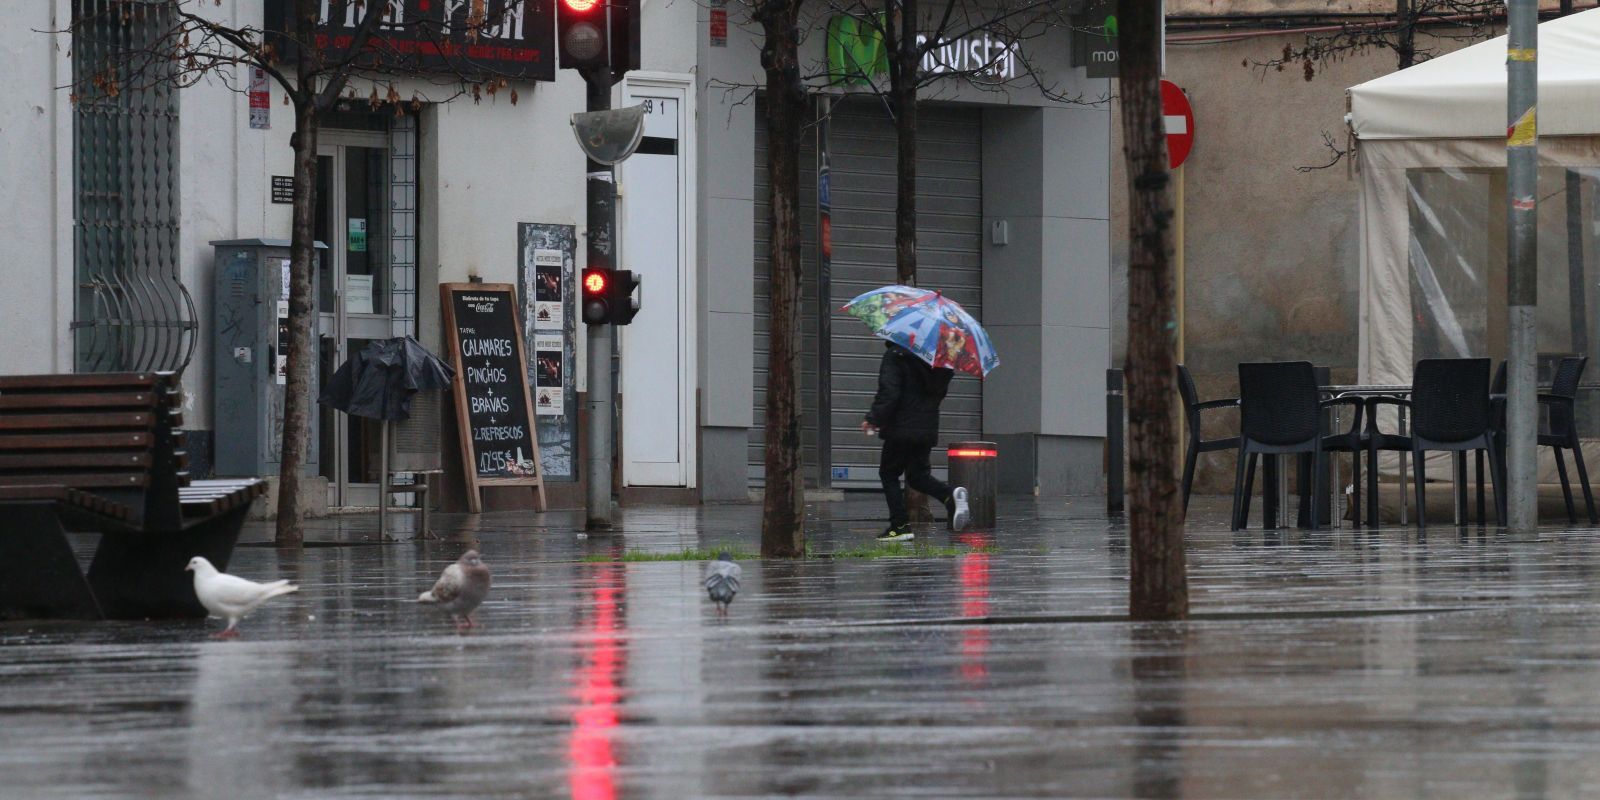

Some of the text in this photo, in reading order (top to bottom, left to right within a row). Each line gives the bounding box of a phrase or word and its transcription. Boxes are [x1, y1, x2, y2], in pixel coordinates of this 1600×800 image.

[462, 338, 512, 357] CALAMARES
[467, 366, 507, 384] PINCHOS
[471, 396, 509, 414] BRAVAS
